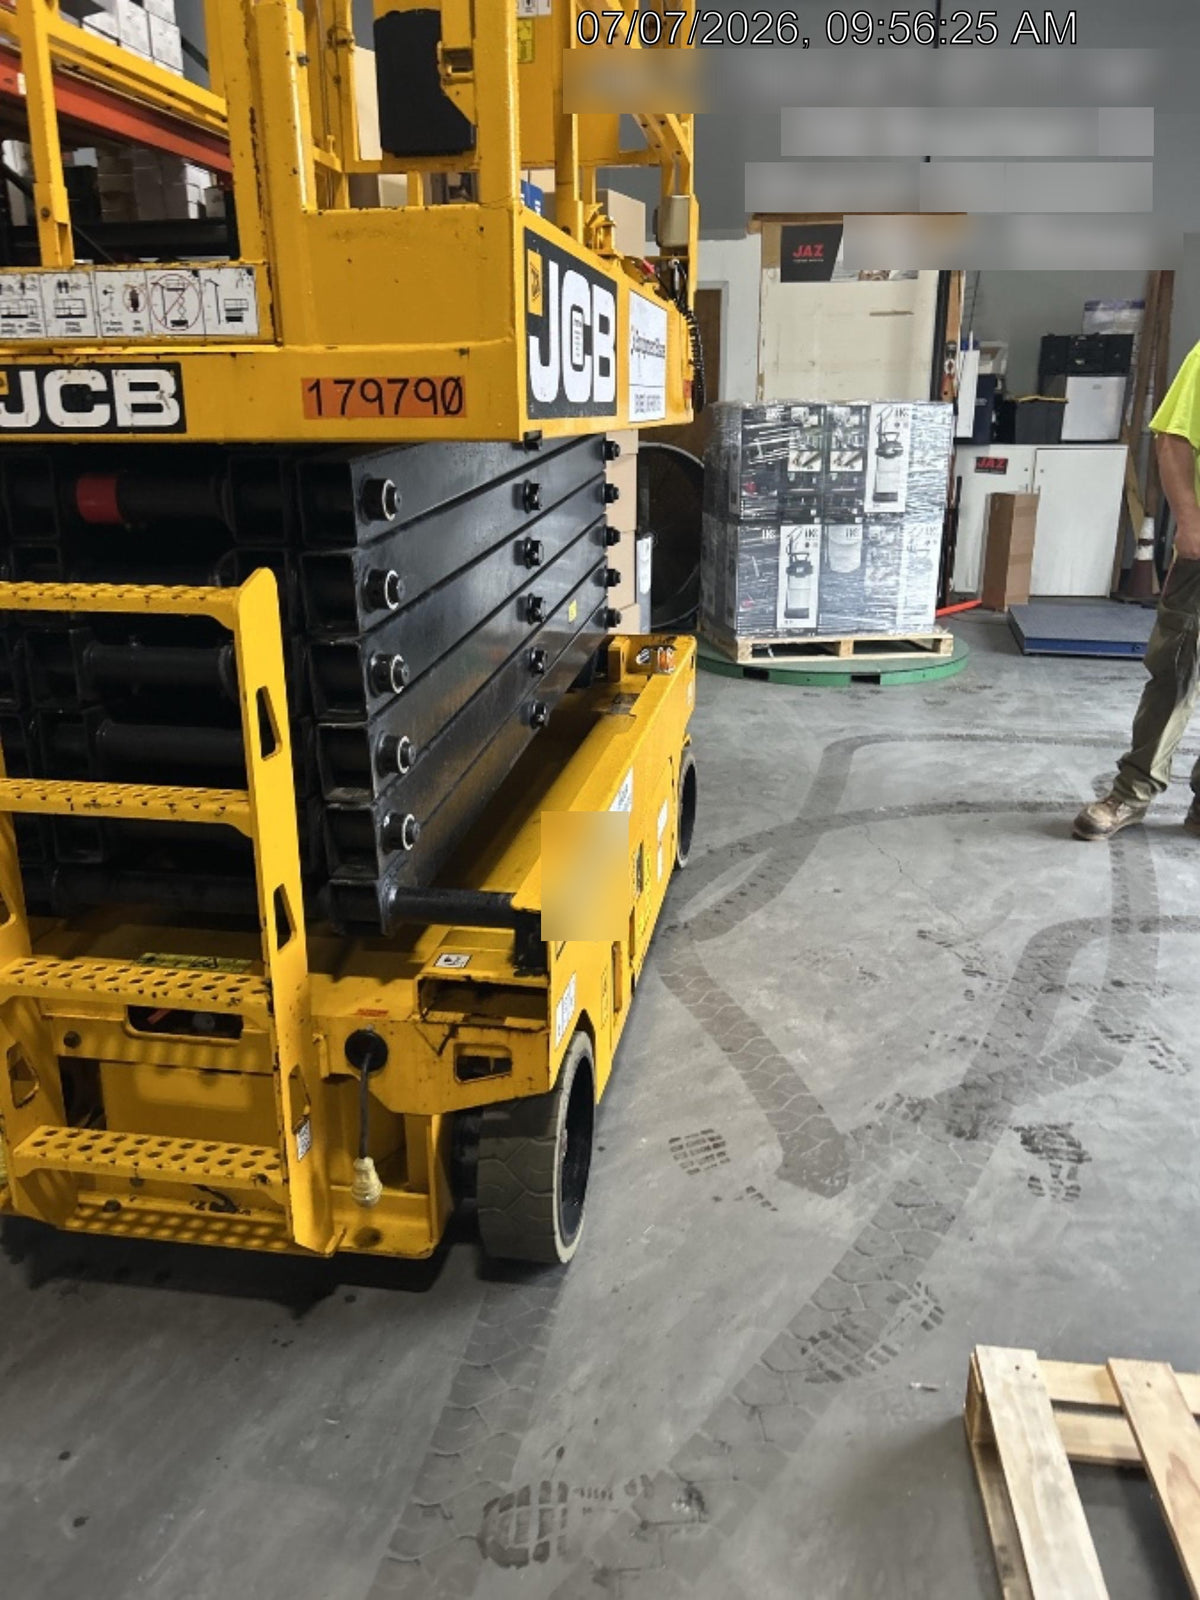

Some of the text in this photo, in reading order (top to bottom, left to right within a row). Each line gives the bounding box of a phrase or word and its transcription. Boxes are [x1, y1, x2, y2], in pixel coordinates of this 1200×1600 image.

[528, 259, 616, 402] JCB
[0, 369, 180, 427] JCB
[307, 376, 463, 416] 179790
